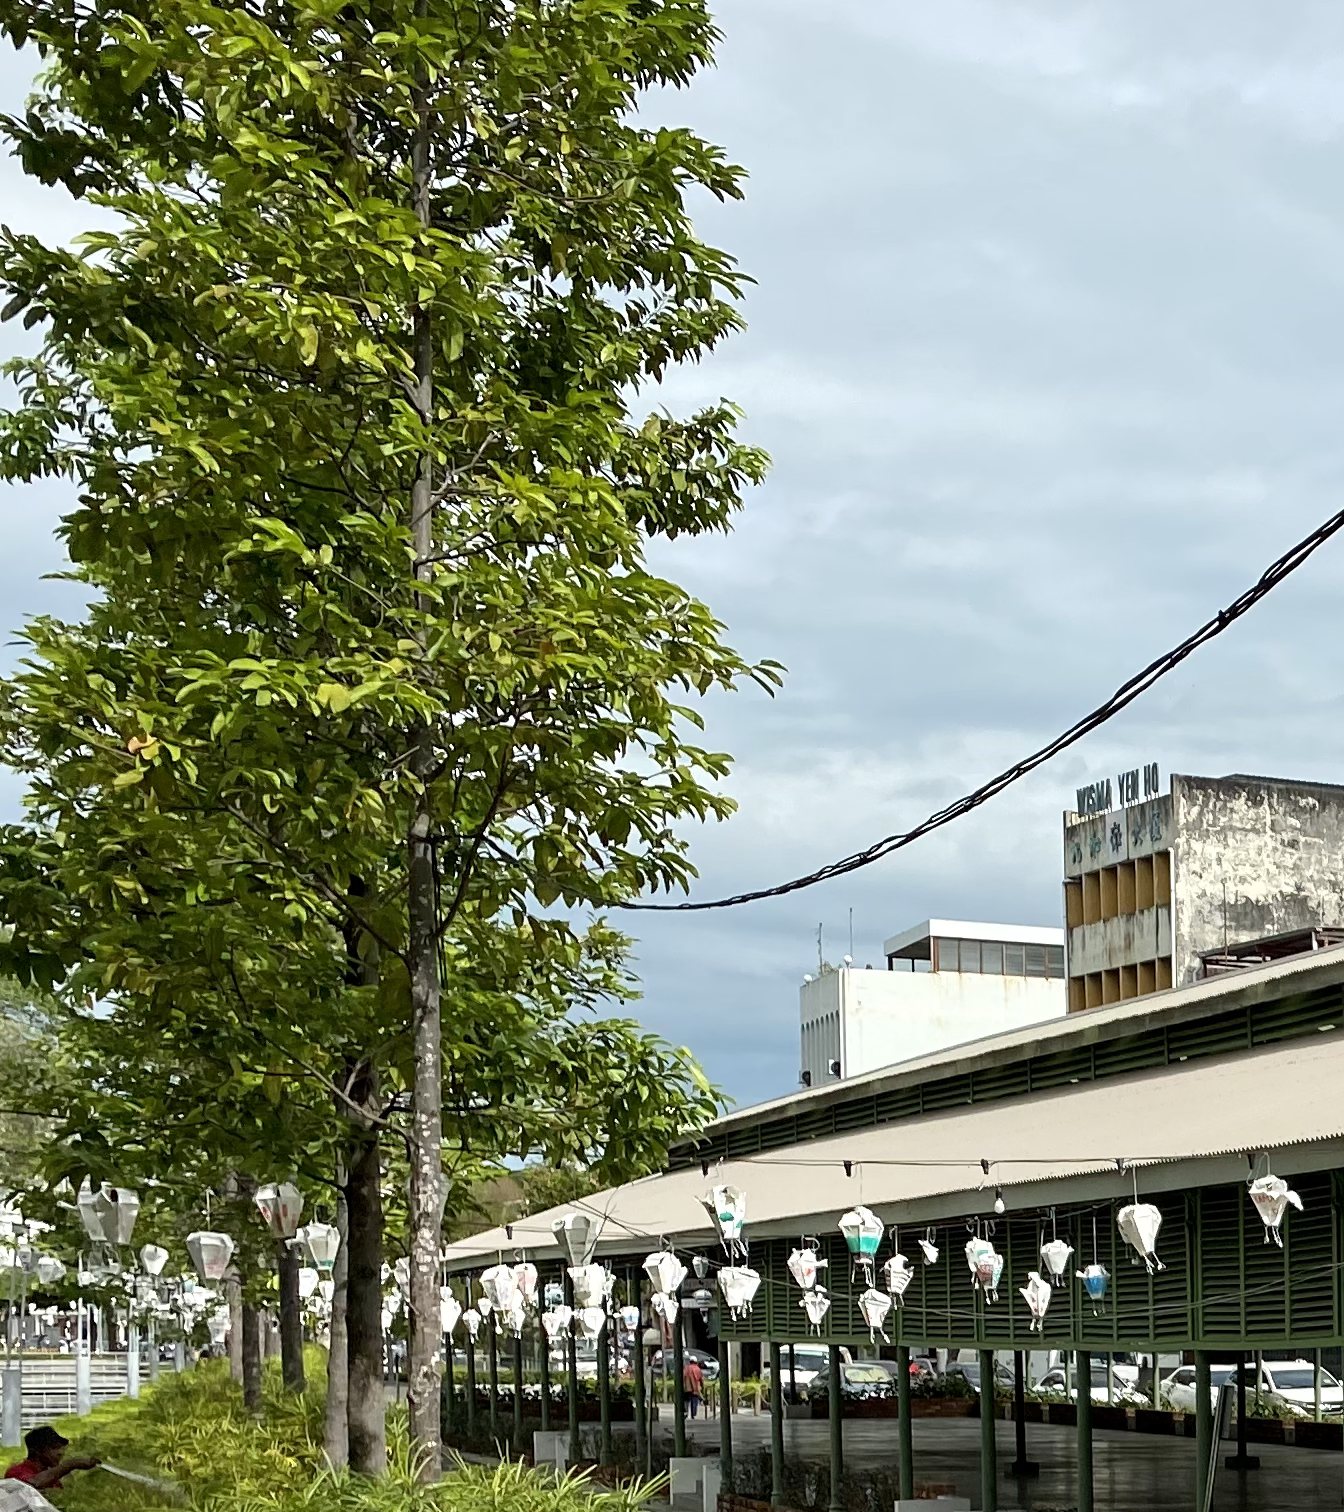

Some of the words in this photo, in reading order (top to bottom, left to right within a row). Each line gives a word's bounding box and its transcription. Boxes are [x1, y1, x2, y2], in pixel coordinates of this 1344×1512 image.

[1076, 778, 1112, 818] WISMA
[1118, 768, 1140, 807] YEN
[1143, 761, 1159, 797] HO
